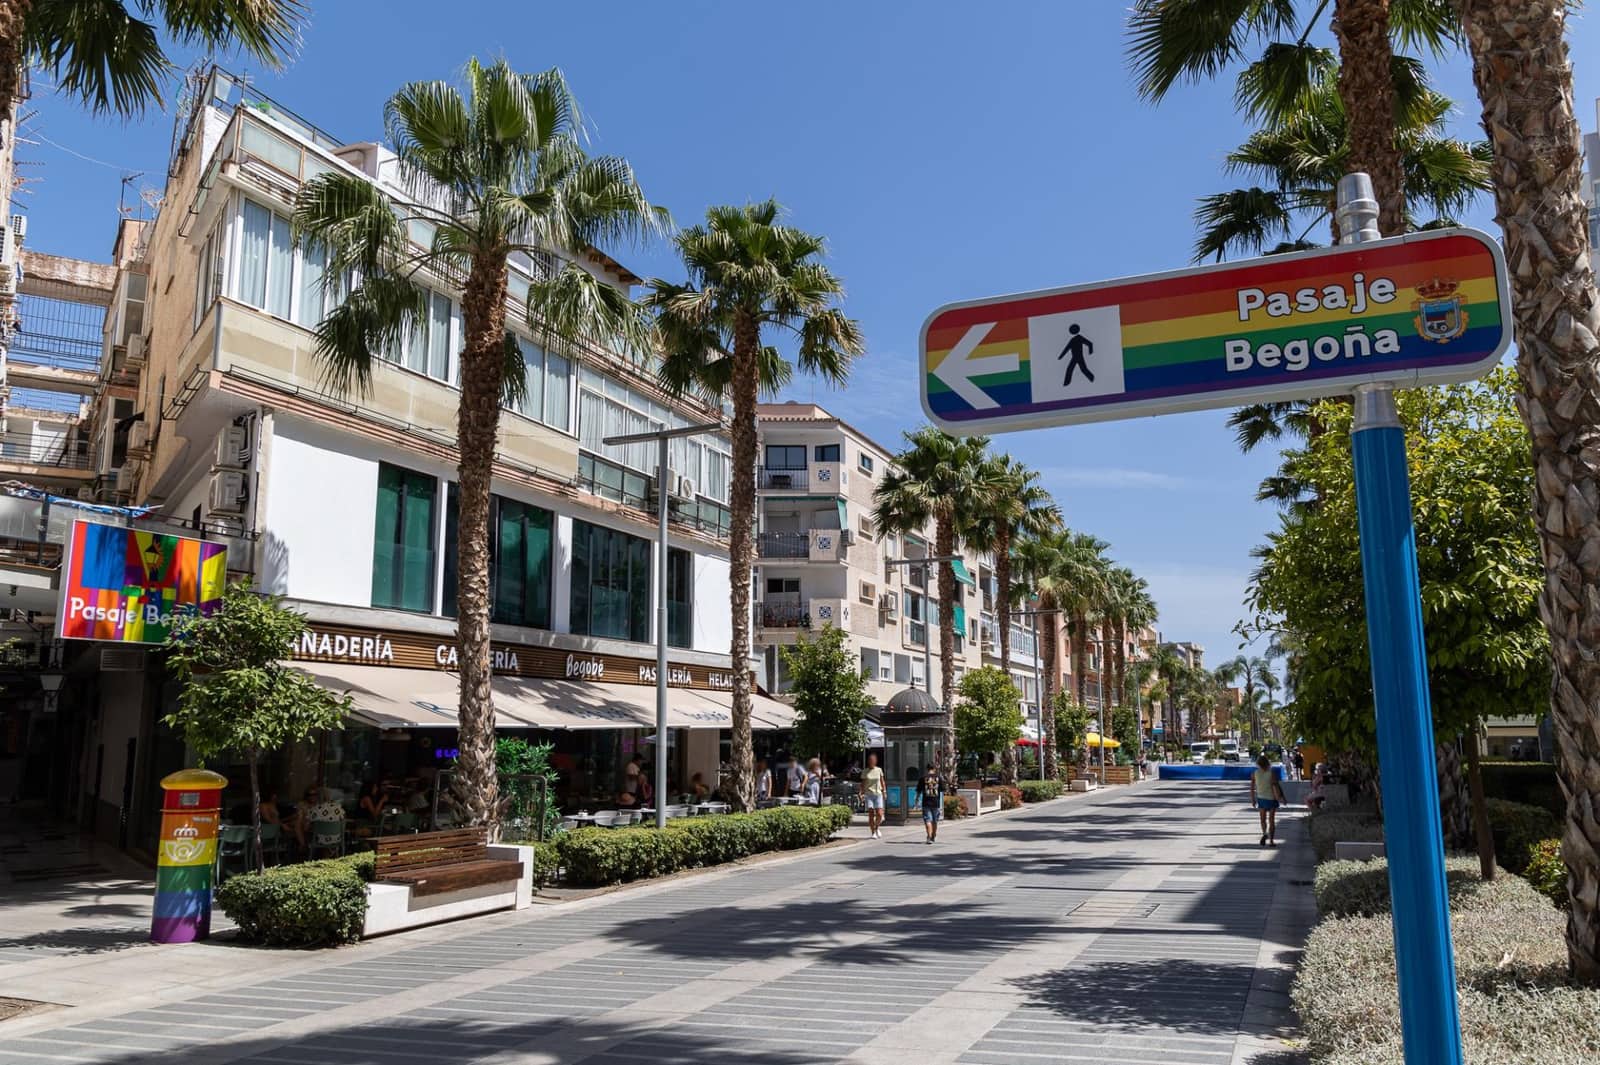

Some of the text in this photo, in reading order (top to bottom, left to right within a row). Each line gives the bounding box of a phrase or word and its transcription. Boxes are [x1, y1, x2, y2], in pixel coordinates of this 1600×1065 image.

[1236, 272, 1397, 322] Pasaje
[1224, 325, 1401, 373] Begoña
[70, 597, 137, 629] Pasaje
[286, 632, 394, 660] ANADERÍA
[436, 643, 519, 670] CAERÍA
[639, 665, 734, 688] PASLERÍA HELAD
